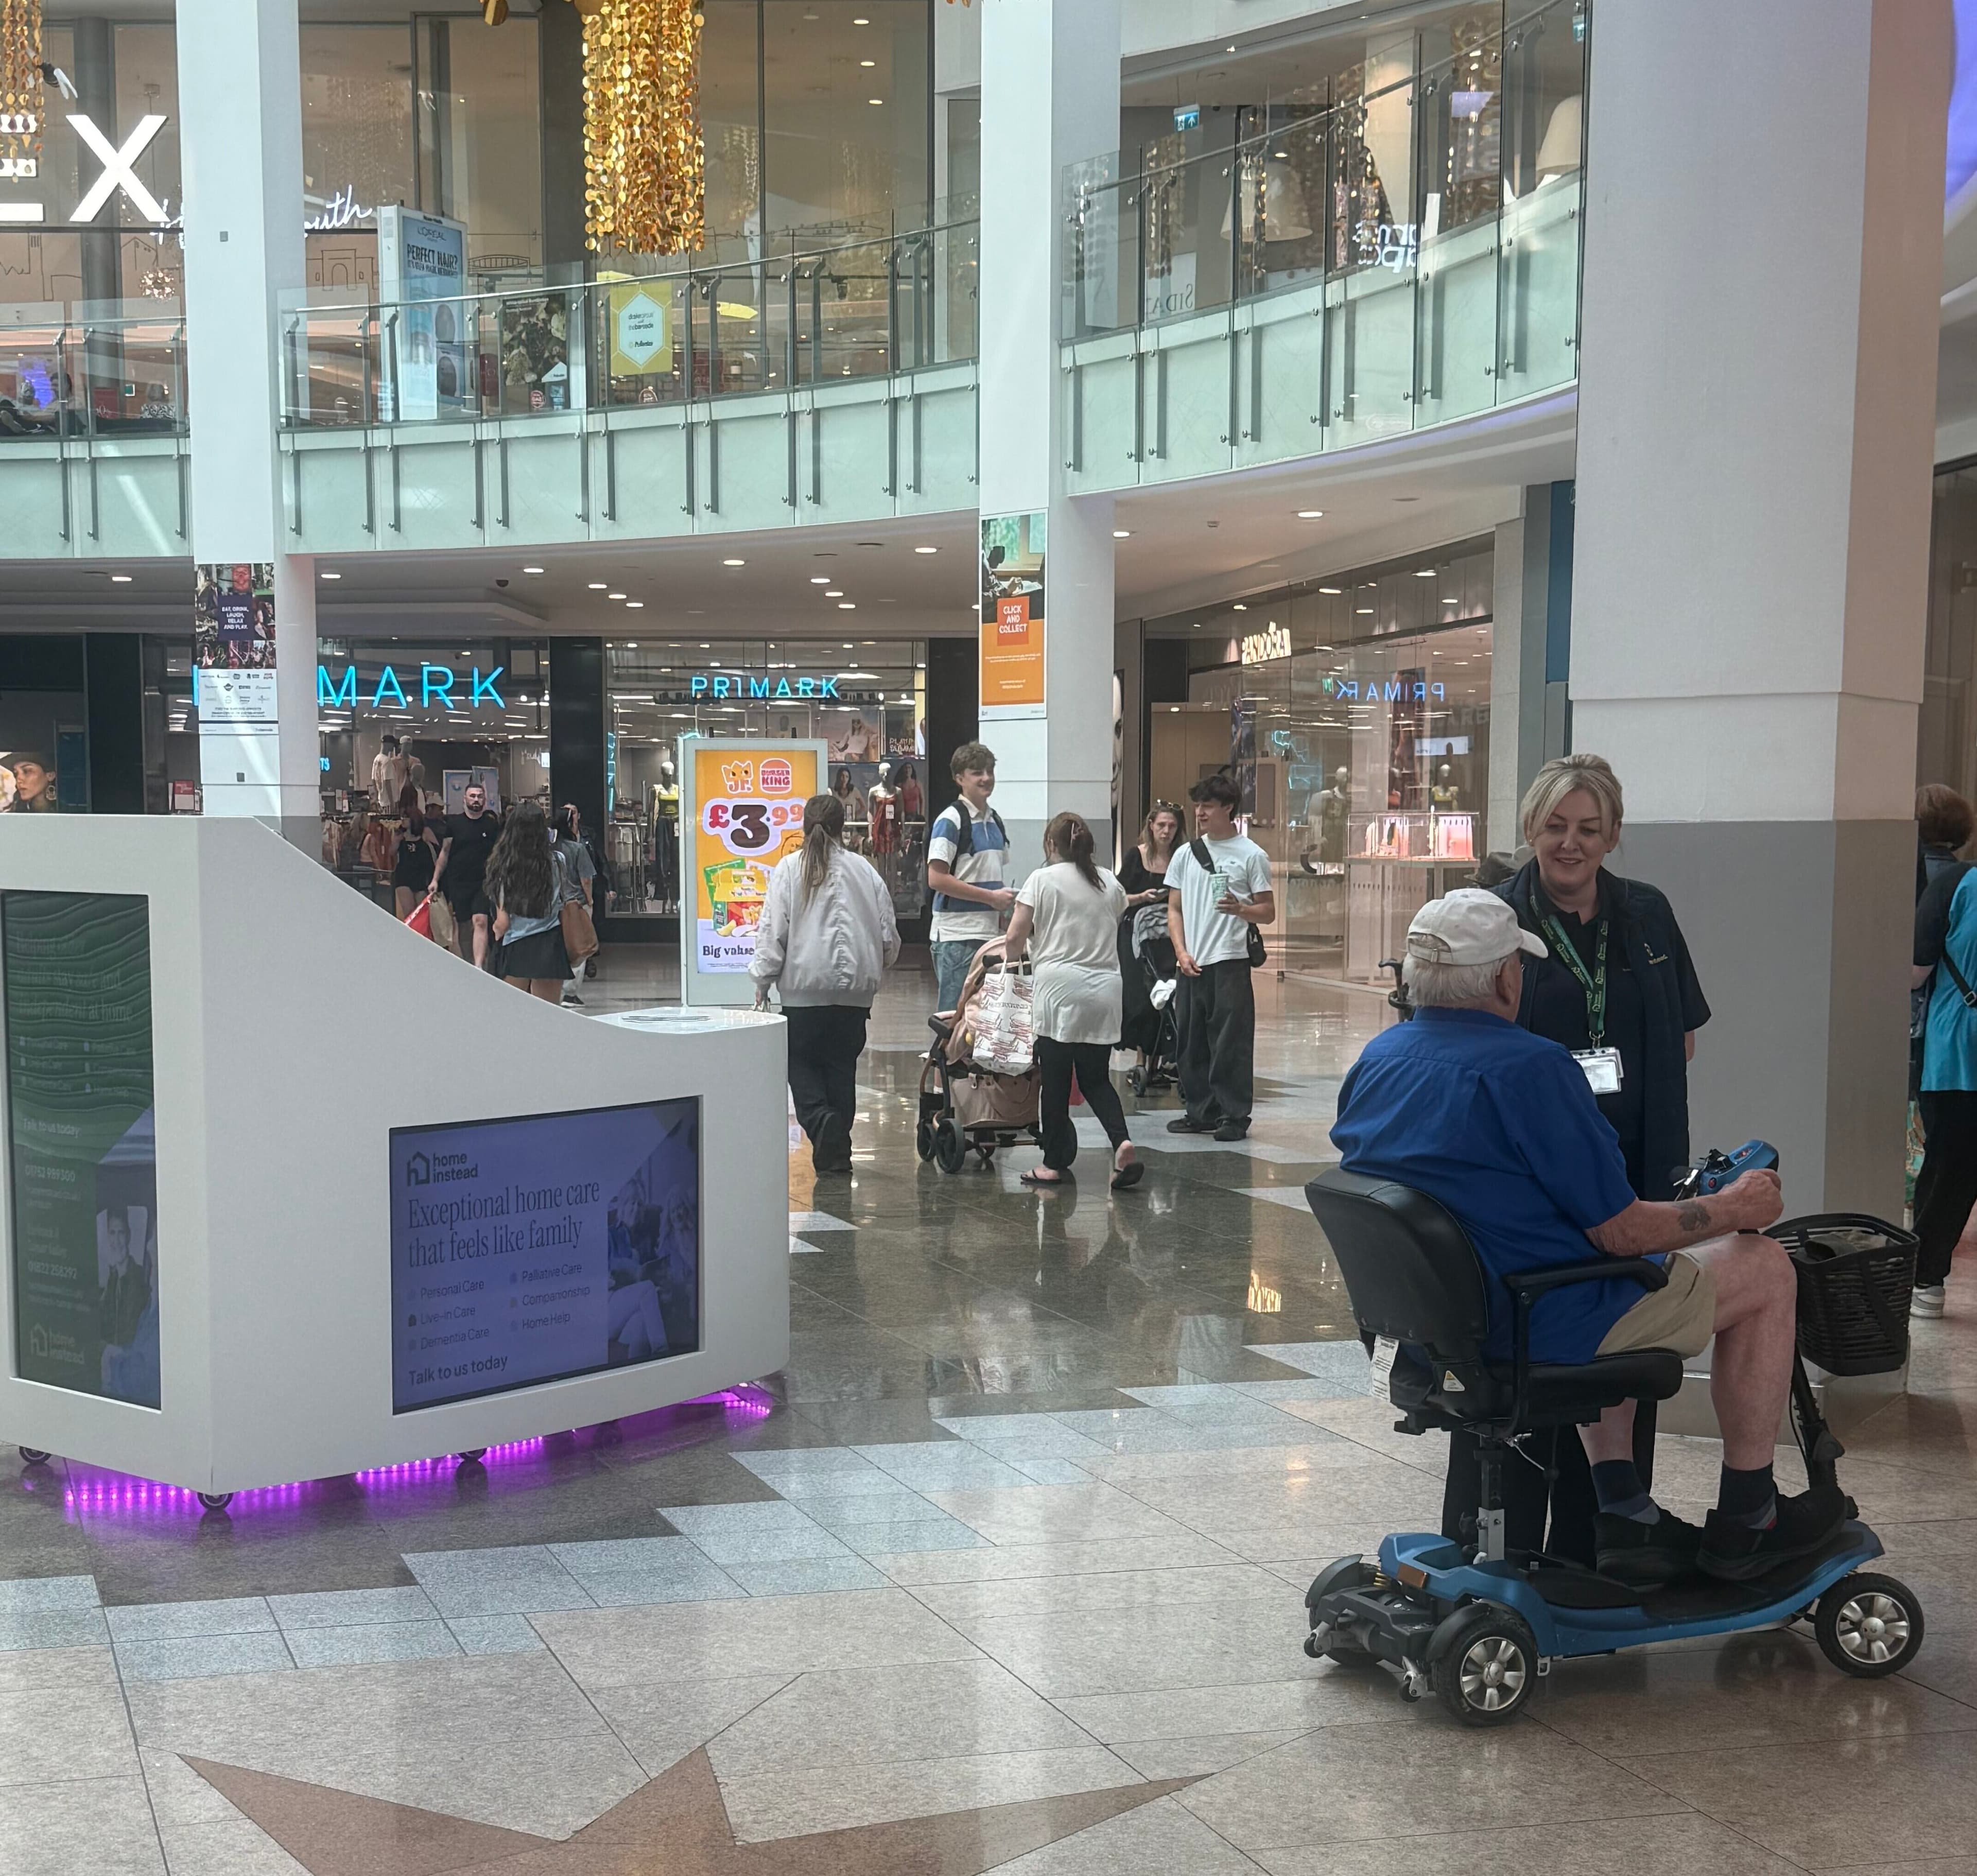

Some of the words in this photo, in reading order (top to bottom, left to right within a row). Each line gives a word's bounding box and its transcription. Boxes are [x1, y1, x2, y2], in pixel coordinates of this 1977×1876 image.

[407, 243, 435, 264] PERFECT
[437, 251, 458, 270] HAIR?
[1003, 605, 1022, 615] CLICK
[1007, 615, 1020, 624] AND
[999, 624, 1028, 634] COLLECT
[691, 676, 840, 699] PRIMARK
[762, 776, 790, 786] KING
[703, 945, 721, 958] Big
[433, 1153, 467, 1167] home
[432, 1164, 478, 1184] instead
[408, 1187, 510, 1230] Exceptional
[515, 1186, 562, 1214] home
[567, 1182, 600, 1205] care
[409, 1236, 445, 1268] that
[449, 1229, 489, 1261] feels
[494, 1225, 524, 1254] like
[528, 1215, 582, 1249] family
[522, 1268, 561, 1281] Palliative
[561, 1263, 582, 1276] Care
[420, 1282, 462, 1299] Personal
[463, 1279, 484, 1292] Care
[522, 1286, 590, 1306] Companionship
[420, 1311, 452, 1325] Live-in
[454, 1307, 476, 1319] Care
[522, 1317, 551, 1330] Home
[551, 1312, 571, 1326] Help
[420, 1333, 467, 1350] Dementia
[467, 1328, 490, 1342] Care
[409, 1367, 435, 1386] Talk
[438, 1366, 452, 1379] to
[454, 1364, 469, 1377] us
[471, 1354, 508, 1374] today
